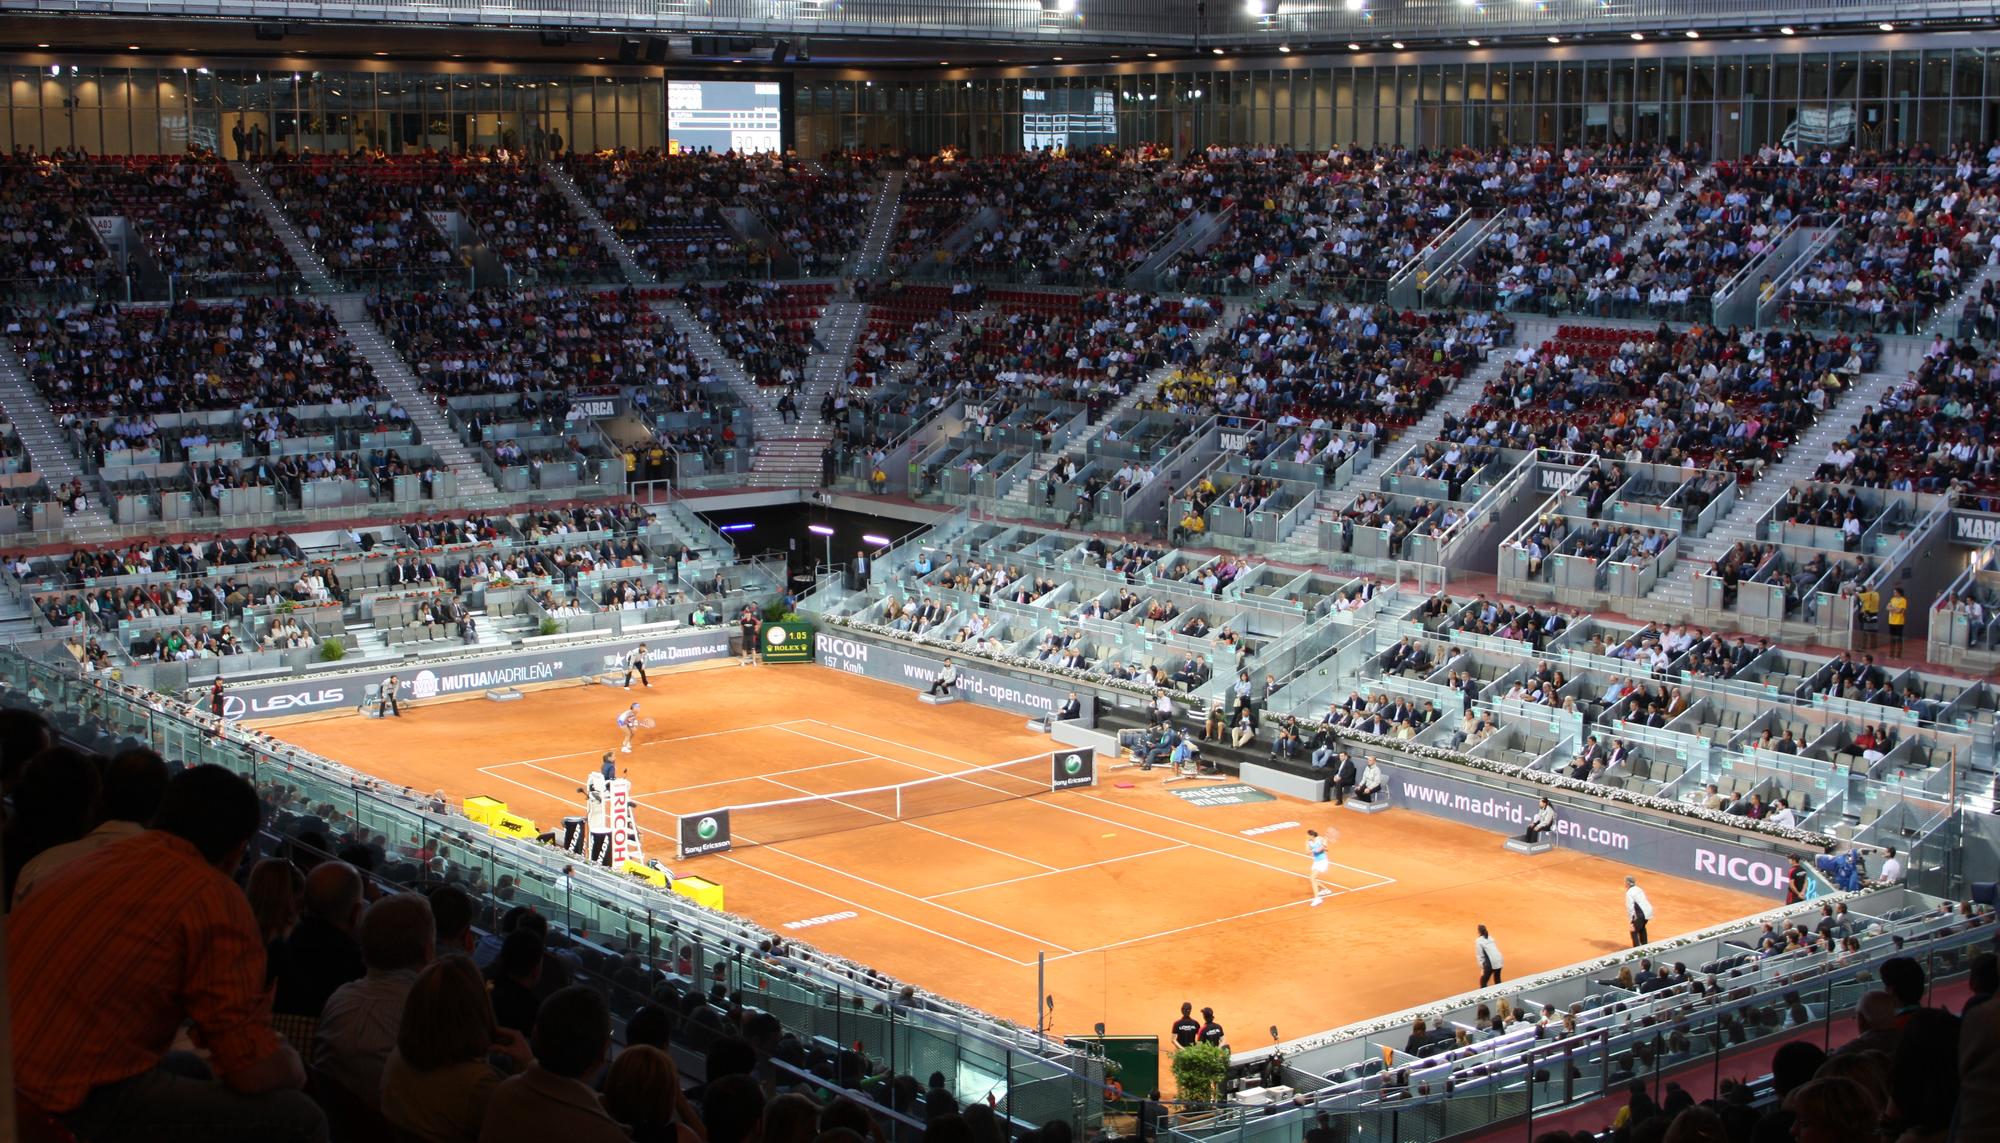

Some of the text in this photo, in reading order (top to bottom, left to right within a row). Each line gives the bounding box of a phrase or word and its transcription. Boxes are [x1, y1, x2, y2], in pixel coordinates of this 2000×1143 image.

[579, 401, 615, 417] ARCA
[774, 644, 800, 652] ROLEX
[816, 635, 867, 661] RICOH
[823, 655, 864, 674] 157 Km/h
[252, 688, 345, 712] LEXUS
[1067, 776, 1092, 785] Ericsson
[614, 792, 627, 862] RICOH
[684, 840, 731, 854] Sony Ericsson
